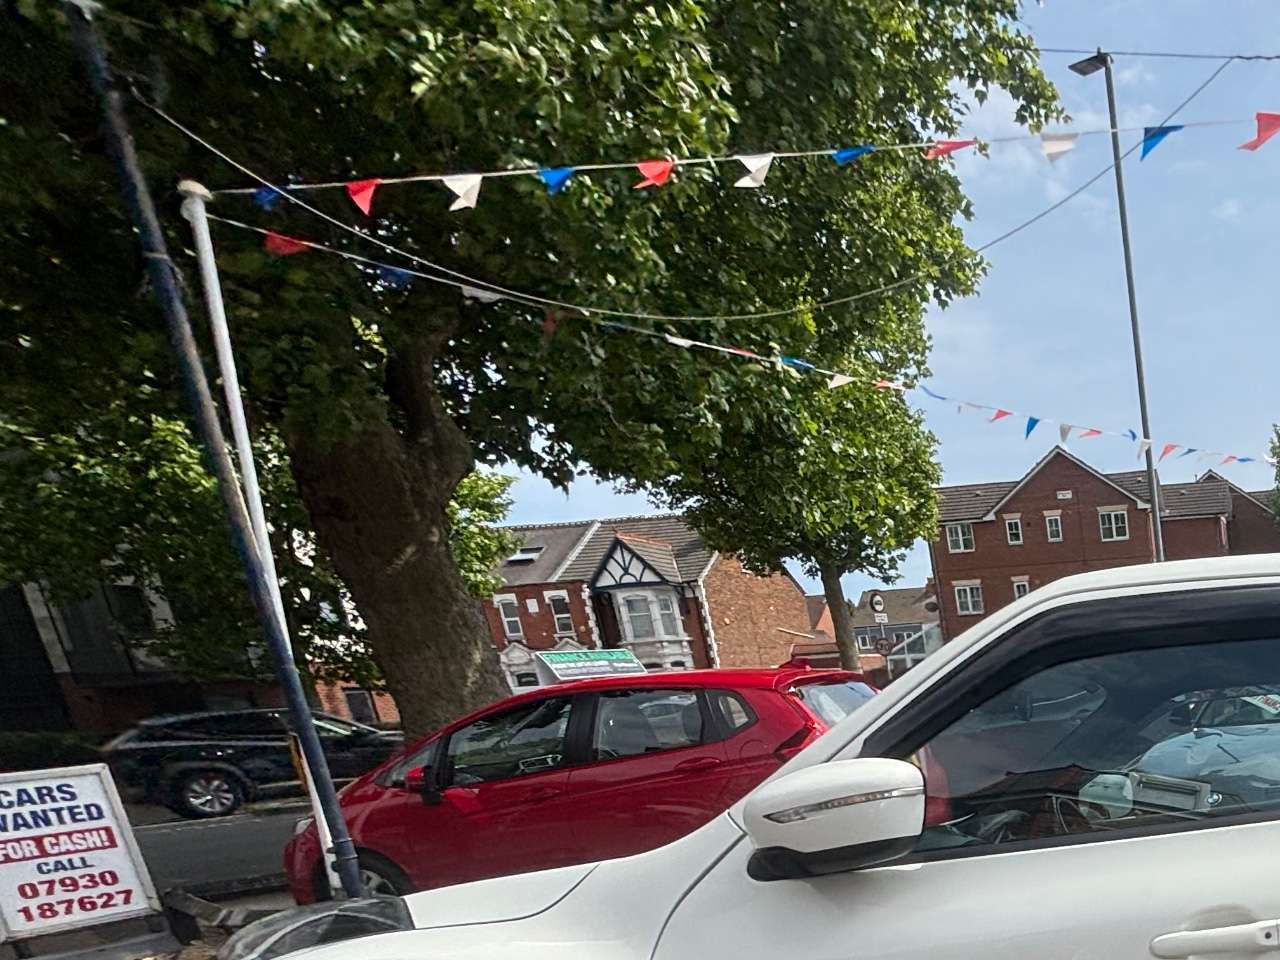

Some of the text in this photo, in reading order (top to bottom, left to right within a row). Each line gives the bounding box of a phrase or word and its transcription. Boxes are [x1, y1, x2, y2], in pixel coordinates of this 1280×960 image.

[0, 783, 79, 810] CARS
[0, 829, 111, 863] FOR CASH!
[36, 857, 96, 875] CALL
[17, 870, 119, 900] 07930
[17, 889, 134, 922] 187627
